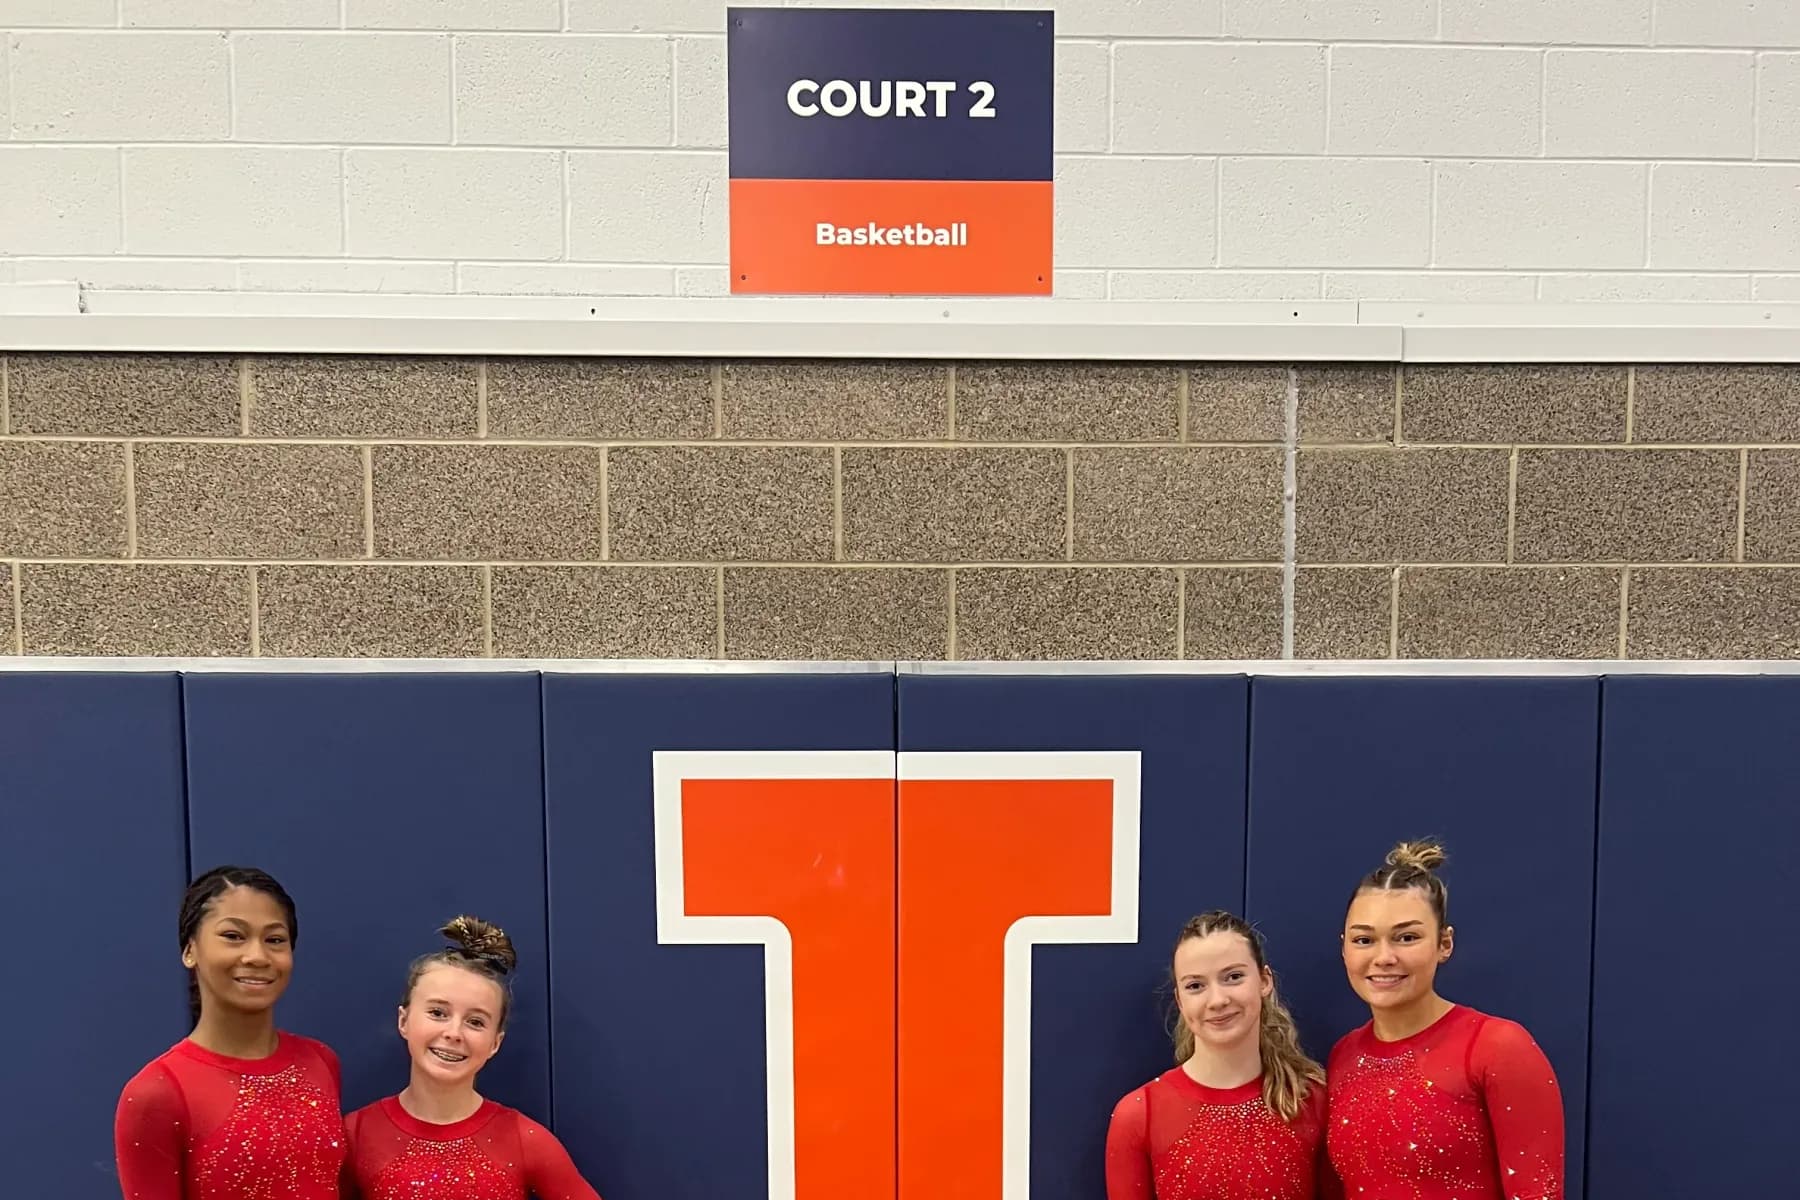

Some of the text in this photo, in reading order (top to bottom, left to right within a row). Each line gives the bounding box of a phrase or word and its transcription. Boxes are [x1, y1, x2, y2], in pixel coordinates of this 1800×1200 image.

[786, 79, 996, 118] COURT 2
[815, 222, 967, 246] Basketball
